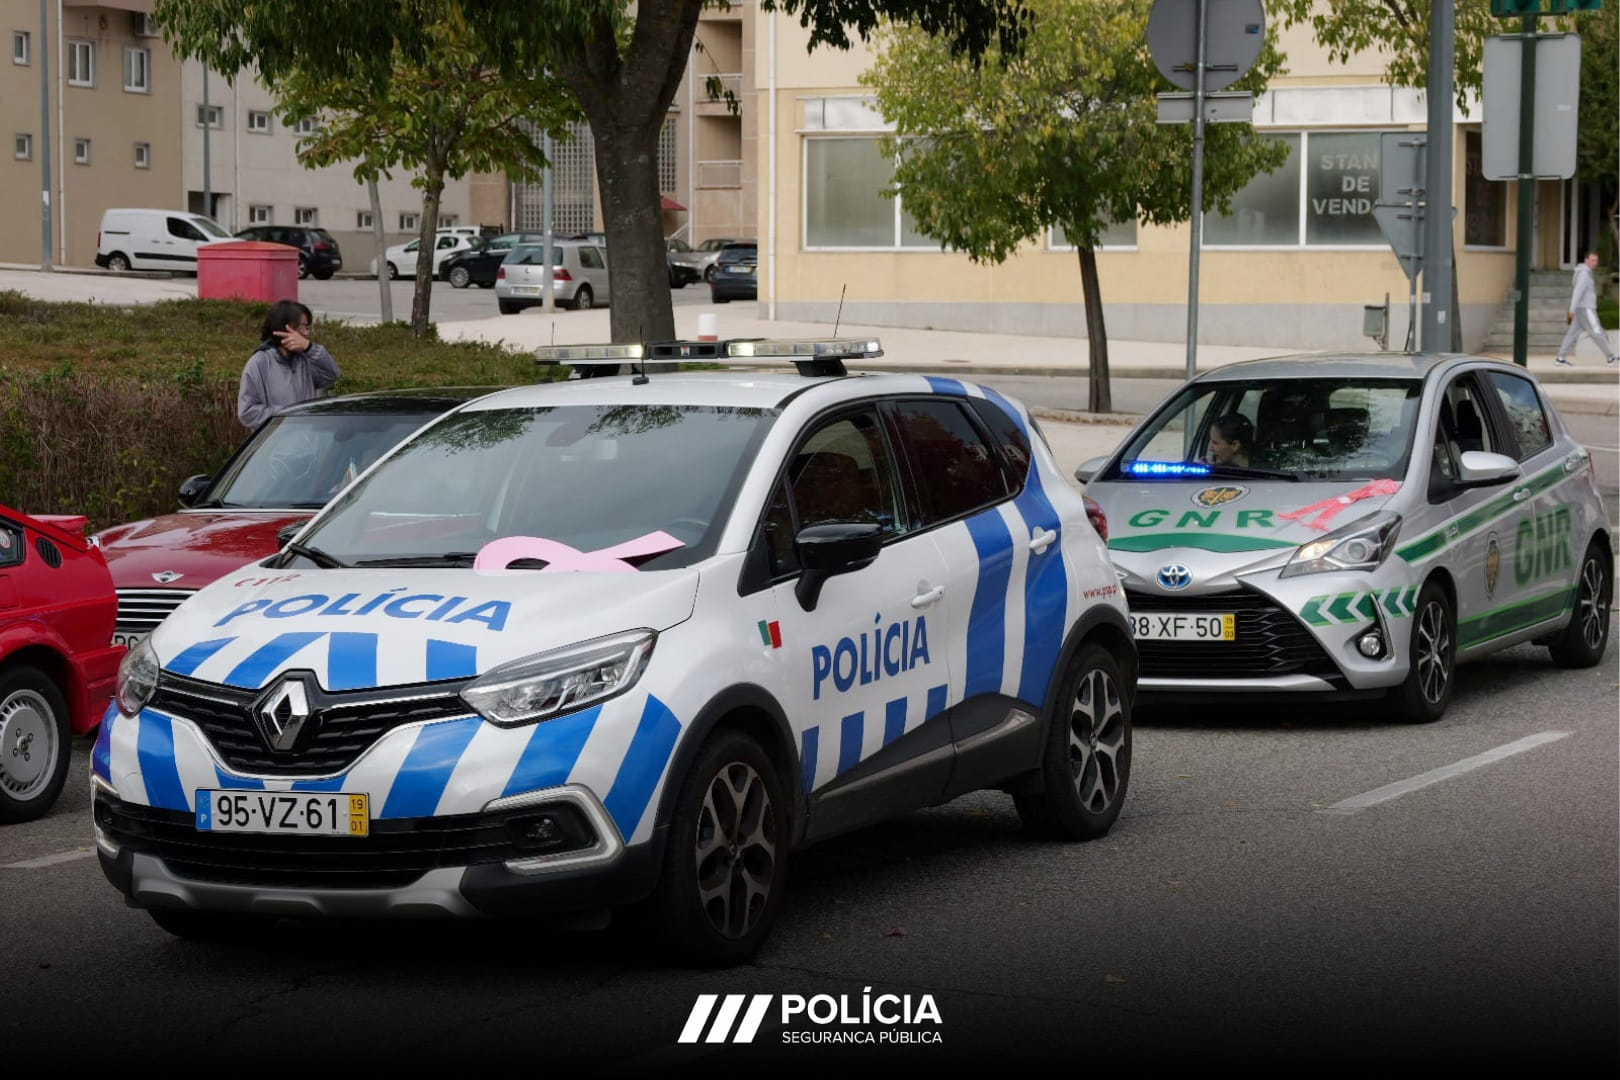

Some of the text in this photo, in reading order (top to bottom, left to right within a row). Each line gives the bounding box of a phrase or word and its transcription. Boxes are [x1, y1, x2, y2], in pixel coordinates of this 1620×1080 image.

[1342, 175, 1370, 192] DE
[1312, 198, 1376, 215] VEND
[1128, 509, 1276, 529] GNR
[1514, 503, 1573, 587] GNR
[212, 587, 512, 632] POLÍCIA
[811, 611, 930, 701] POLÍCIA
[351, 799, 363, 810] 19
